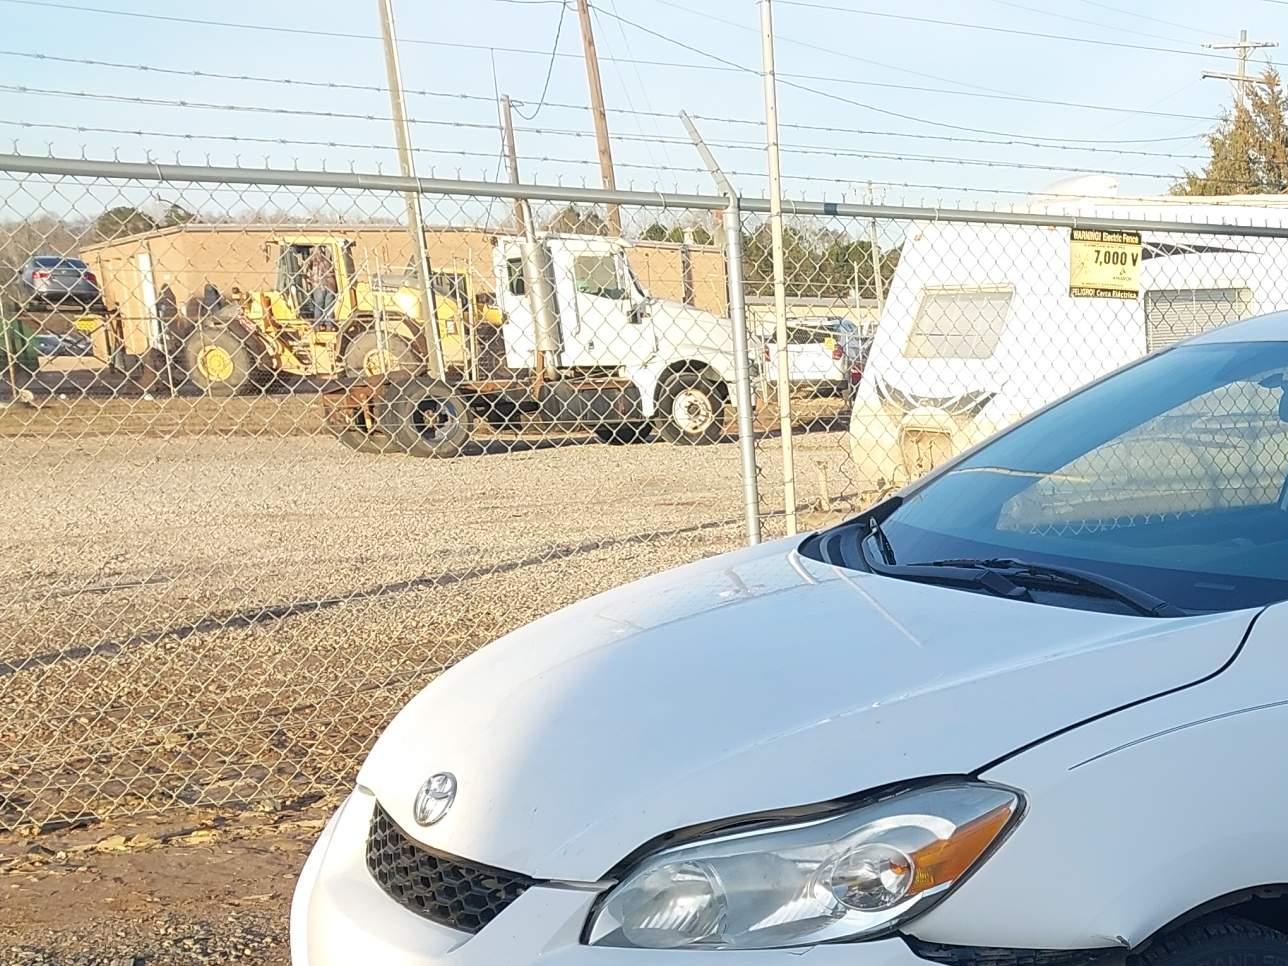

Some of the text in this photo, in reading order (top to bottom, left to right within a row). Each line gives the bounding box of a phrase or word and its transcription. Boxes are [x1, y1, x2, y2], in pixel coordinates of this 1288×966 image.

[1073, 230, 1139, 244] WARNING! Electric Fence
[1094, 249, 1139, 267] 7,000 V
